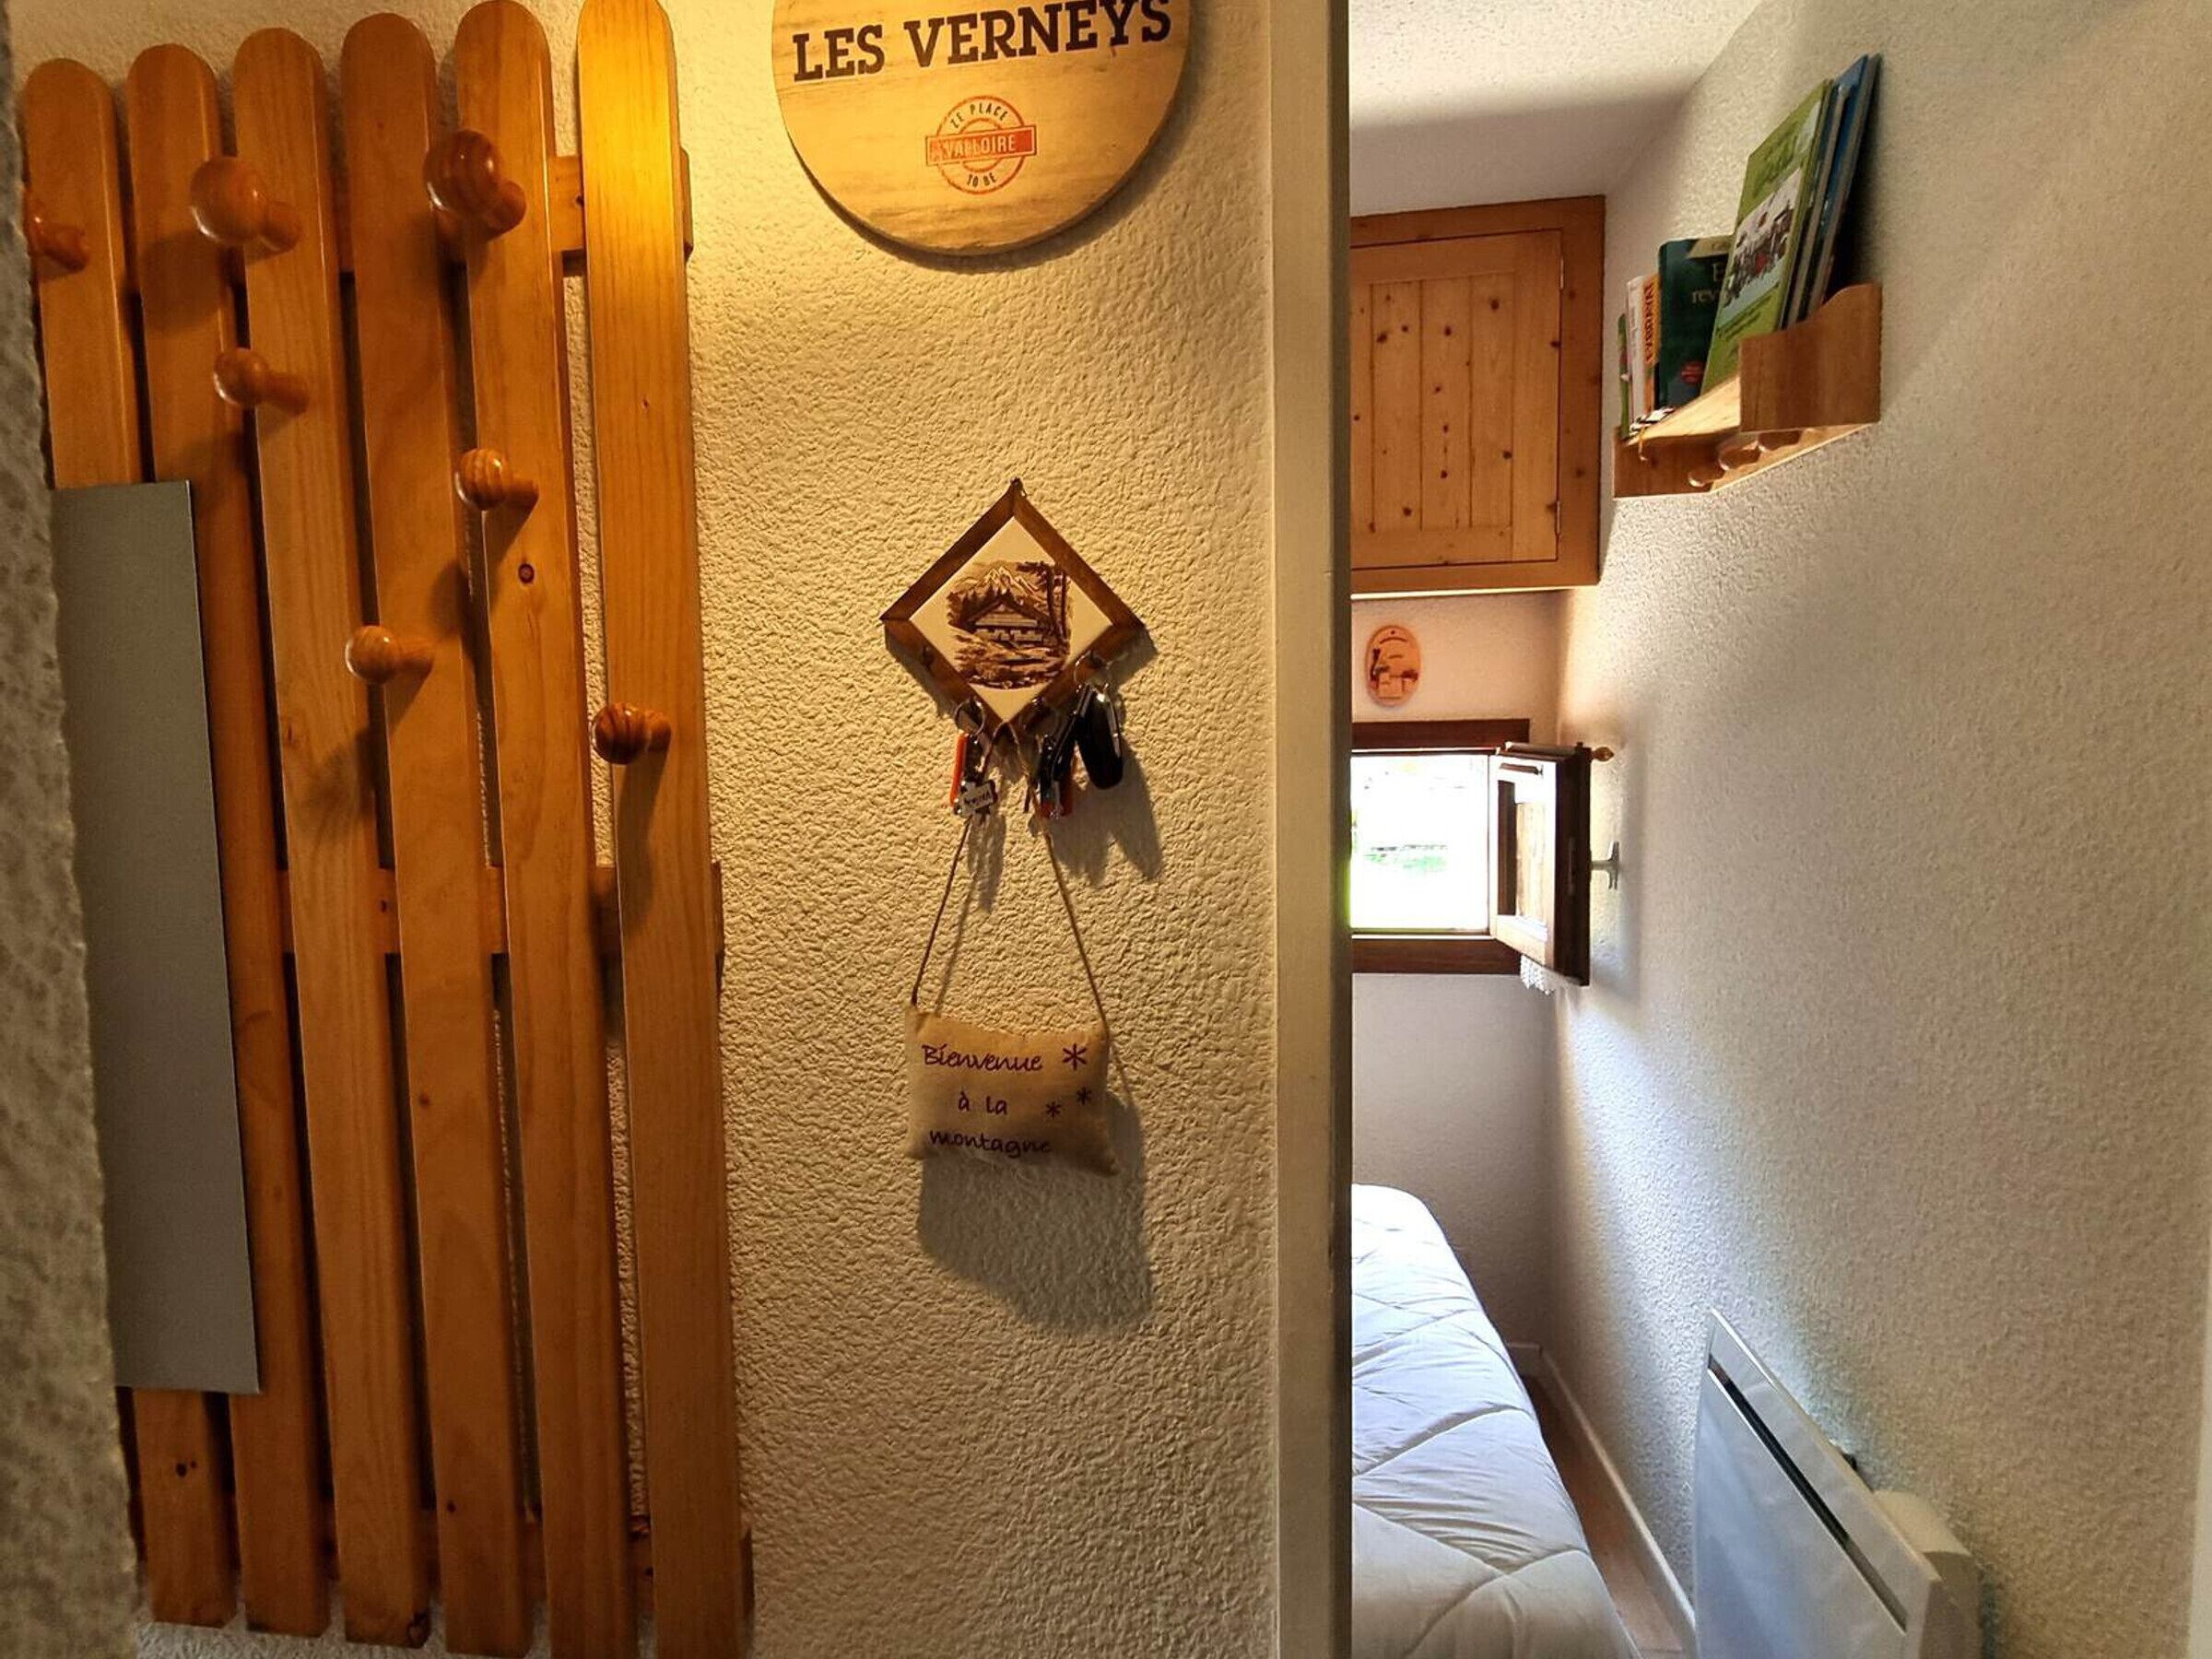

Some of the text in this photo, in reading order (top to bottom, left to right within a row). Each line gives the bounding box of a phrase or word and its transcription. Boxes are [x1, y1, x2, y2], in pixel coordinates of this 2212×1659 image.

[793, 0, 1172, 82] LES VERNEYS
[950, 102, 1008, 129] ZE PLACE
[943, 134, 1017, 158] VALLOIRE
[966, 171, 996, 188] TO BE
[922, 1043, 1043, 1072] Bienvenue
[958, 1091, 1007, 1115] à la
[929, 1129, 1052, 1159] montagne
